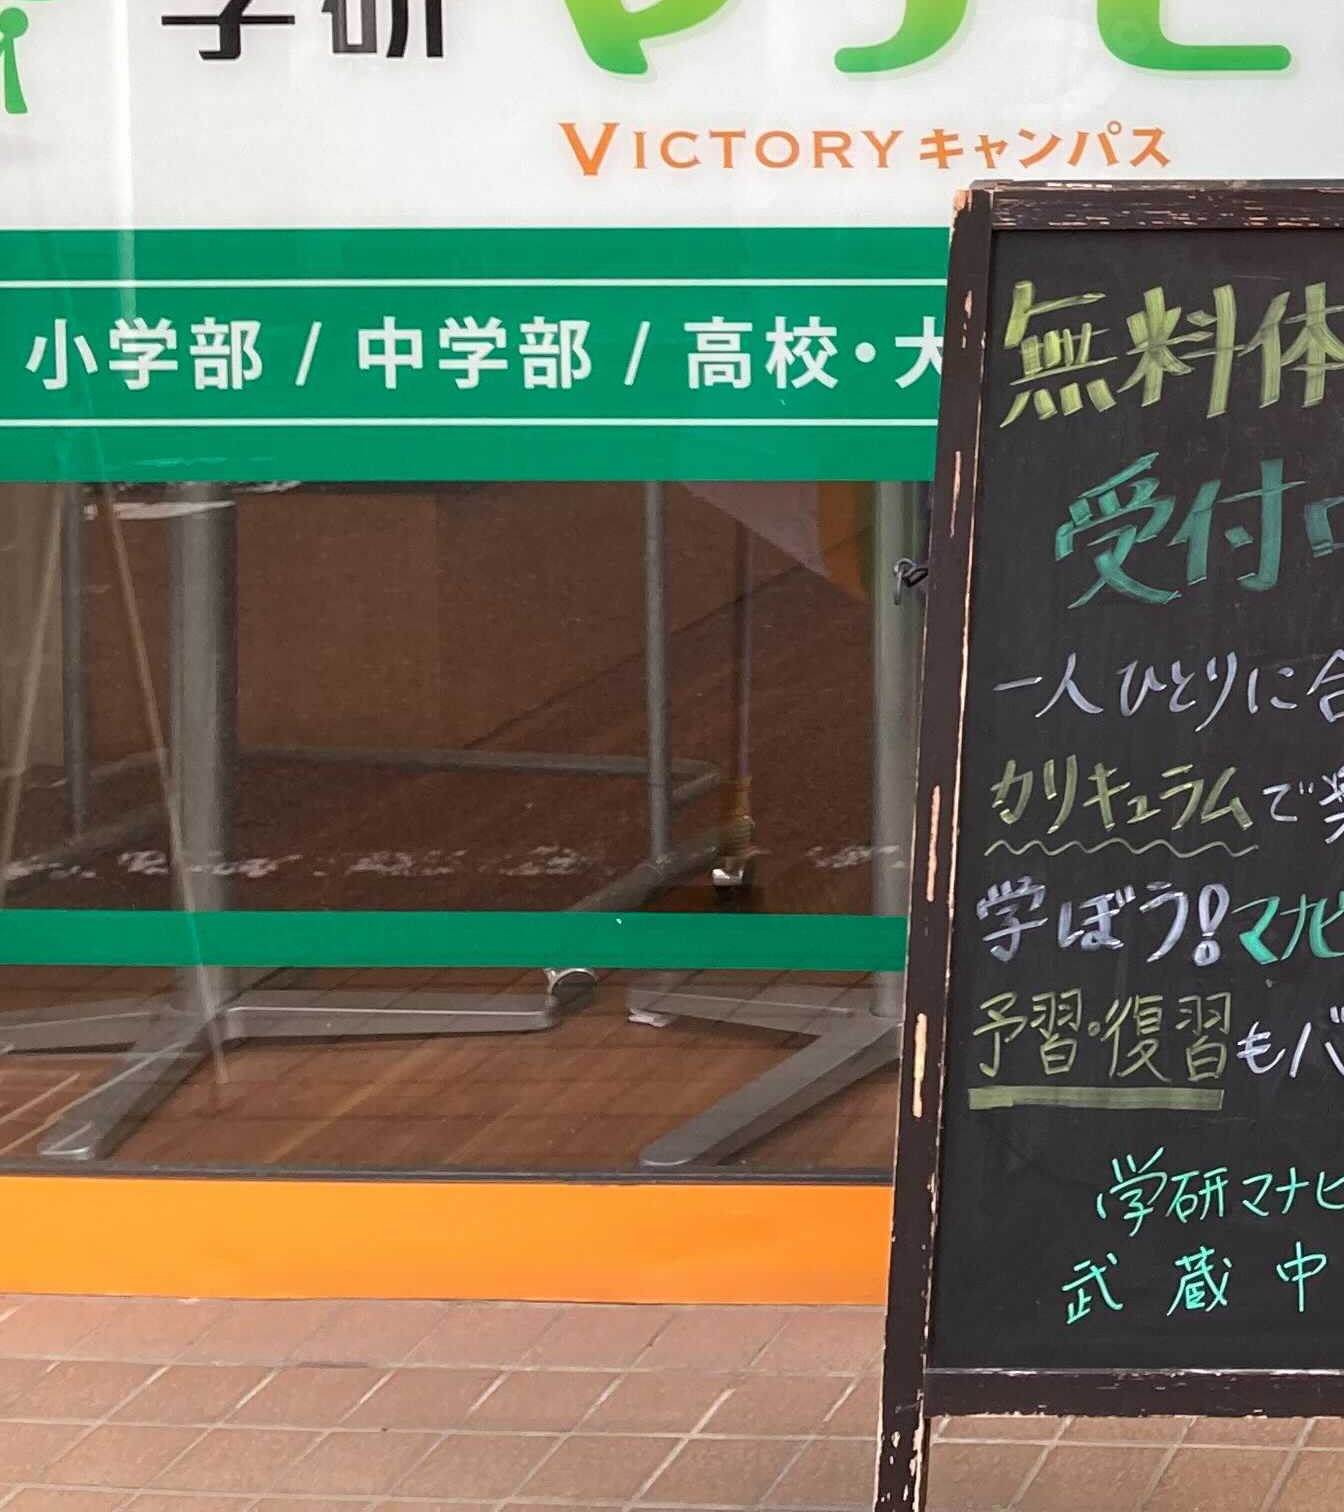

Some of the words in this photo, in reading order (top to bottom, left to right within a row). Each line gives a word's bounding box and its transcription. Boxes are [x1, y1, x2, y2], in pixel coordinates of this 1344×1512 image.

[26, 317, 264, 392] 小学部
[357, 317, 593, 390] 中学部
